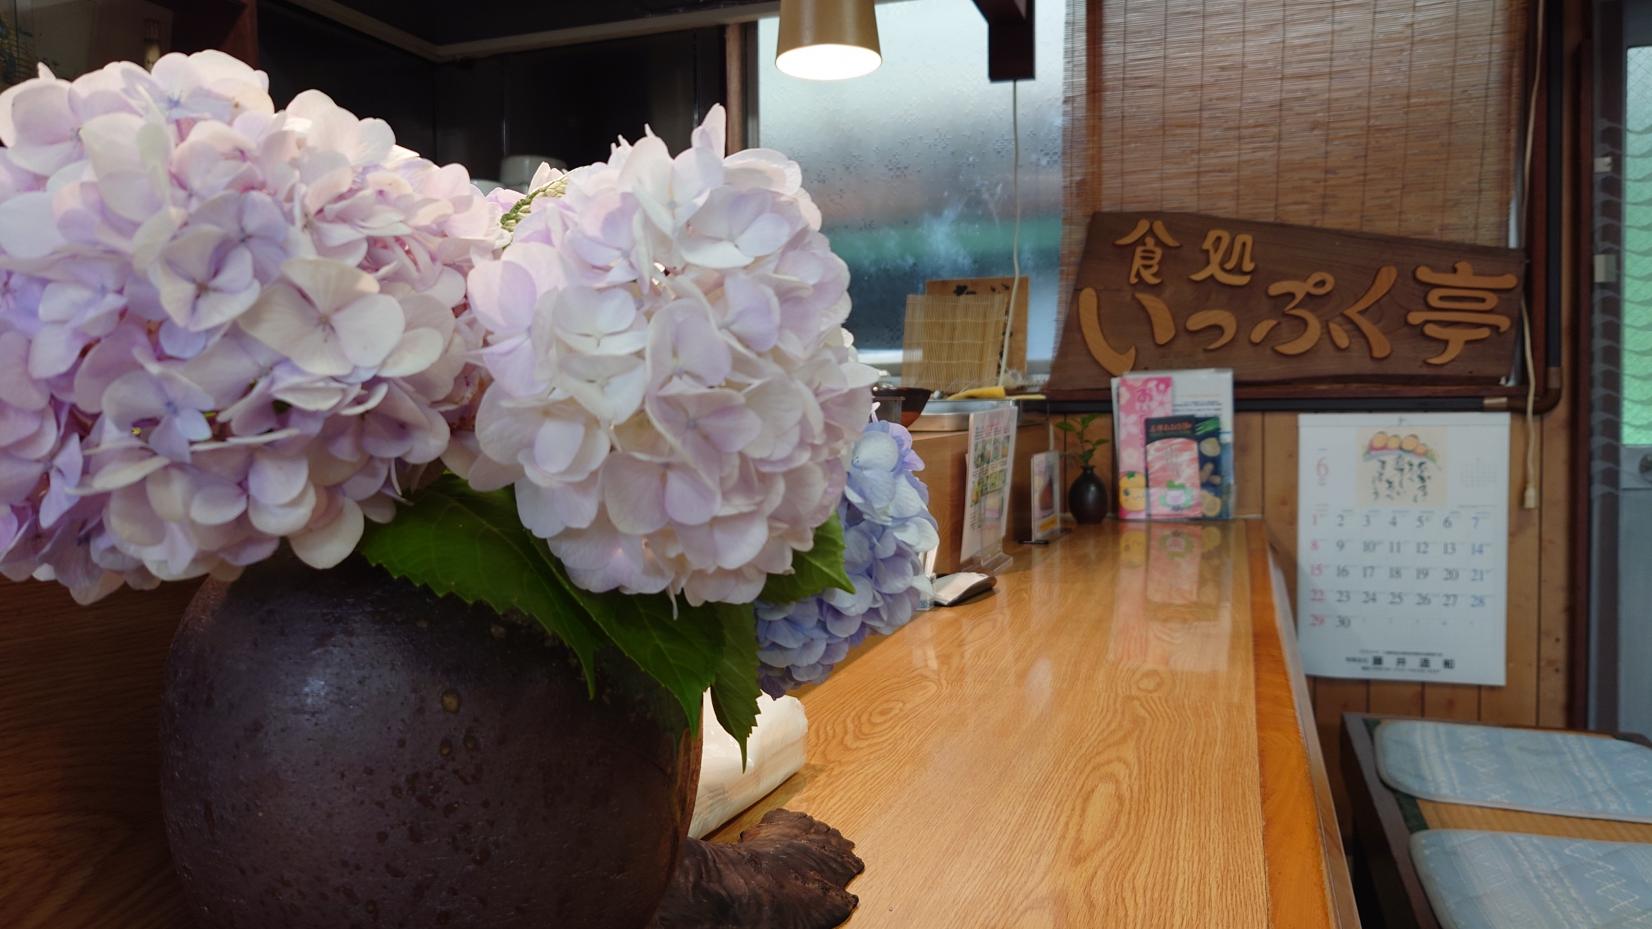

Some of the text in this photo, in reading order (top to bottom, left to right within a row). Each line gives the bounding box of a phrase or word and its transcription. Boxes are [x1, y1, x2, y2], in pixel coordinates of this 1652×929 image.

[1114, 219, 1256, 286] 食処
[1079, 260, 1518, 376] いっぷく亭
[1316, 457, 1329, 477] 6
[1363, 540, 1377, 552] 10
[1389, 541, 1401, 553] 11
[1416, 541, 1429, 554] 12
[1443, 542, 1456, 554] 13
[1472, 544, 1483, 555] 14
[1337, 565, 1349, 577] 16
[1363, 566, 1375, 578] 17
[1390, 568, 1401, 578] 18
[1416, 568, 1429, 579] 19
[1443, 568, 1458, 581] 20
[1471, 569, 1484, 581] 21
[1310, 589, 1485, 607] 22 23 24 25 26 27 28
[1311, 614, 1324, 627] 29
[1336, 616, 1351, 627] 30
